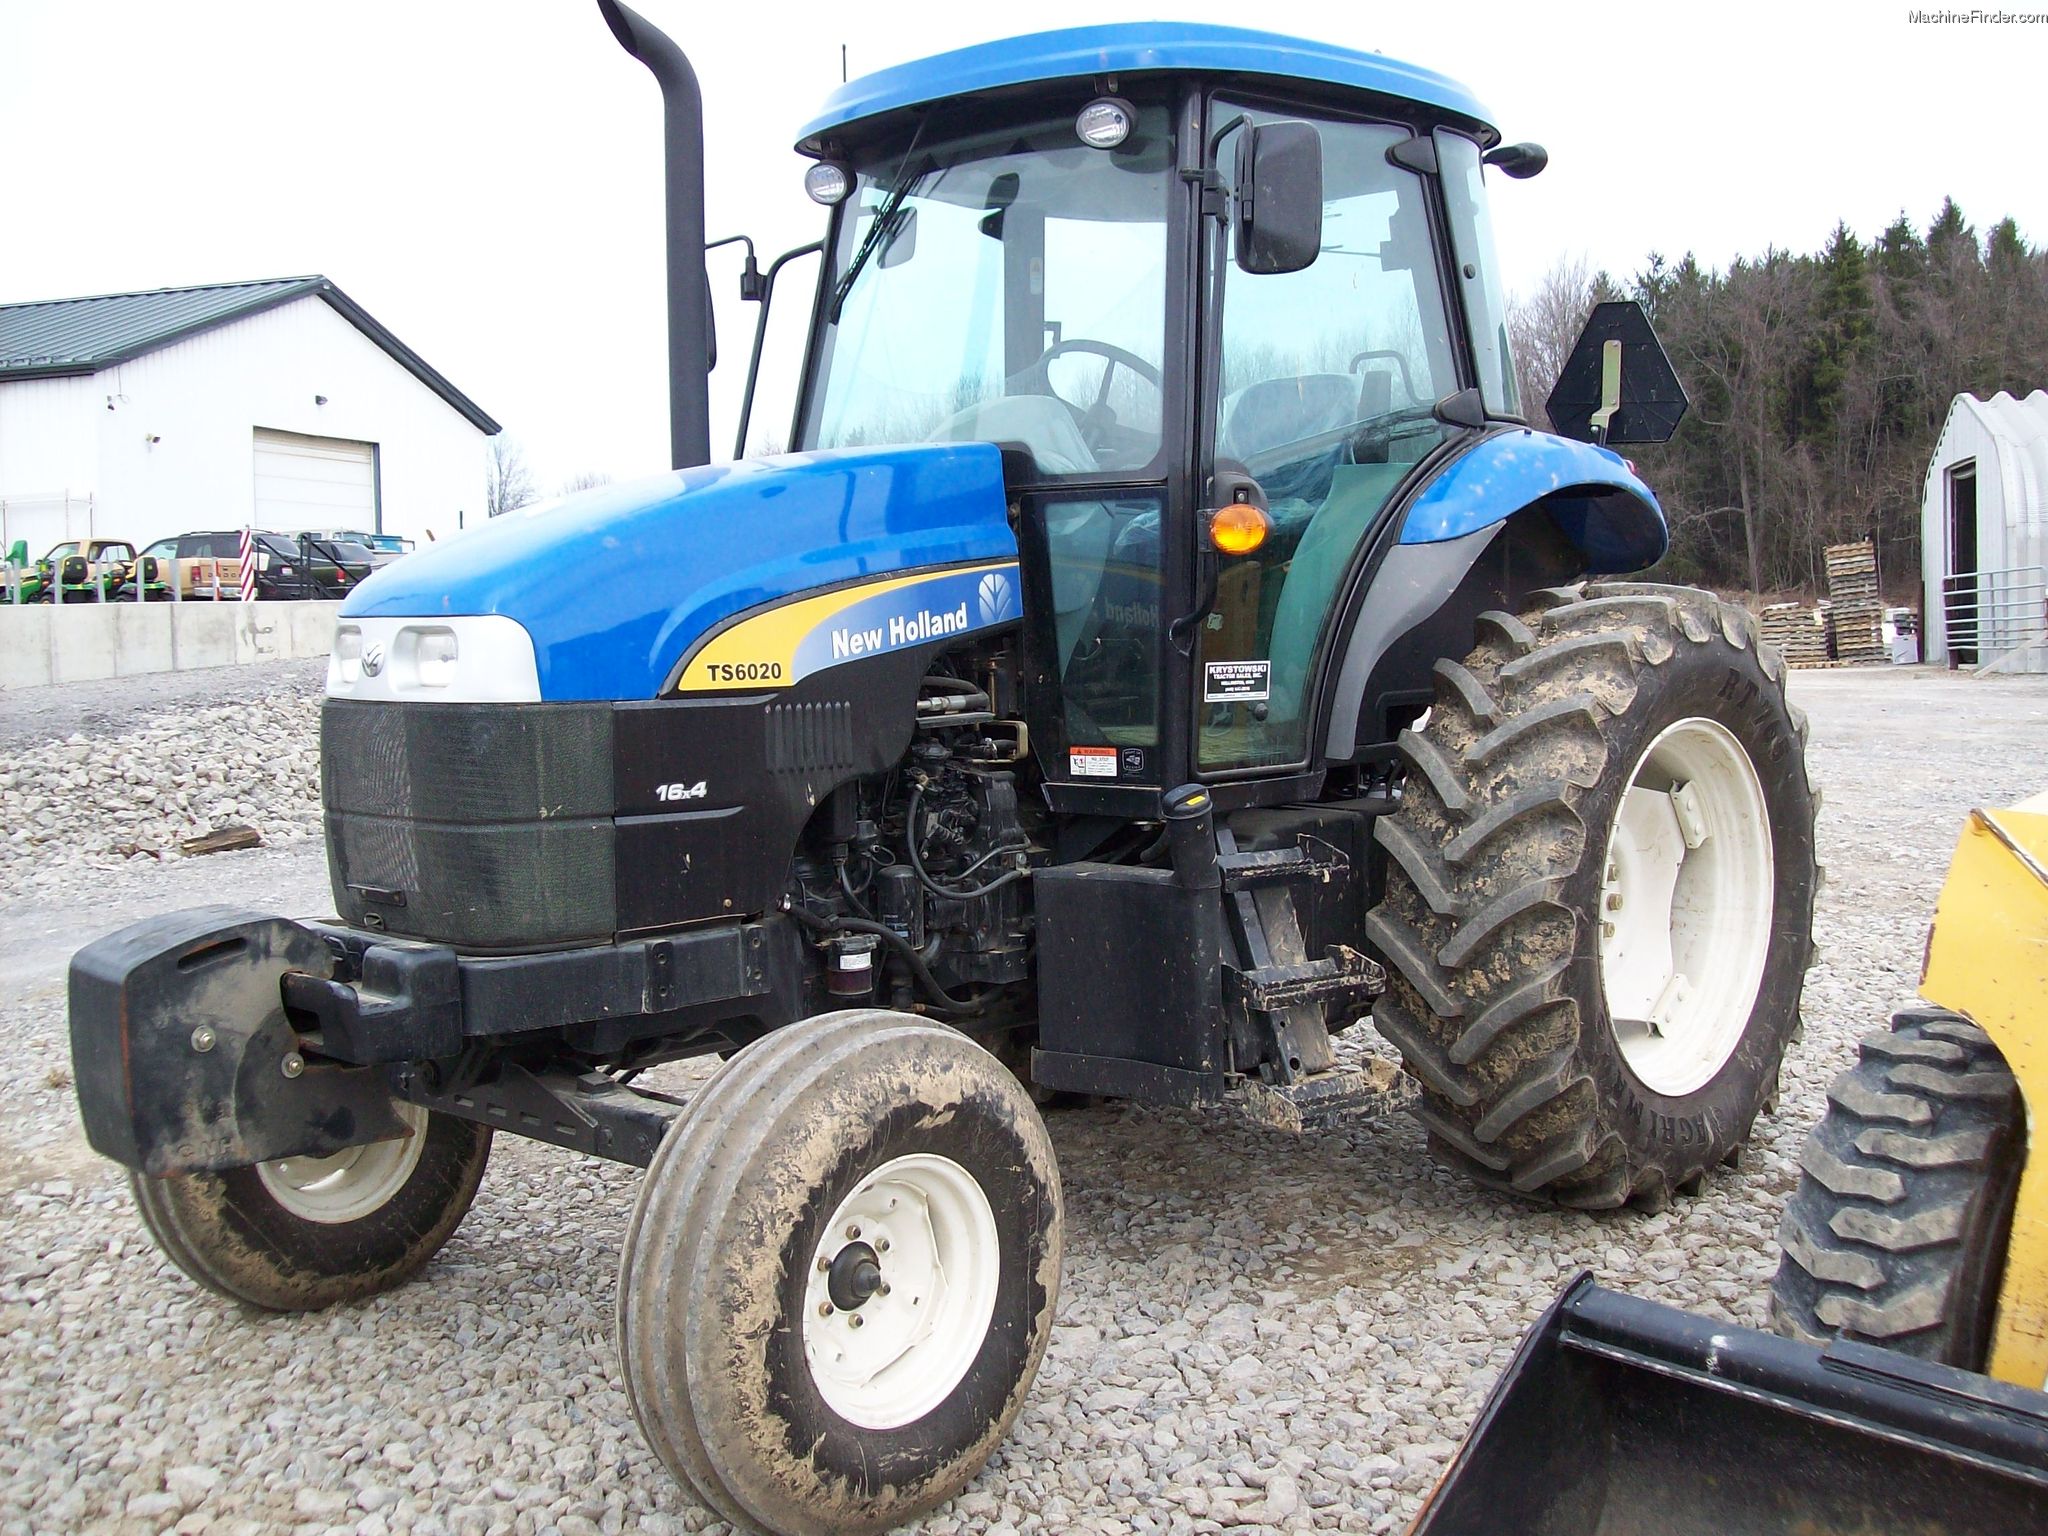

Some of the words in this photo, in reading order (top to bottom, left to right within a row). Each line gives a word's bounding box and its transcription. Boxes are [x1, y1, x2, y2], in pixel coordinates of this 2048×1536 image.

[831, 627, 883, 659] New
[889, 602, 968, 646] Holland
[707, 663, 782, 682] TS6020
[1209, 664, 1267, 675] KRYSTOWSKI
[655, 781, 708, 801] 16x4
